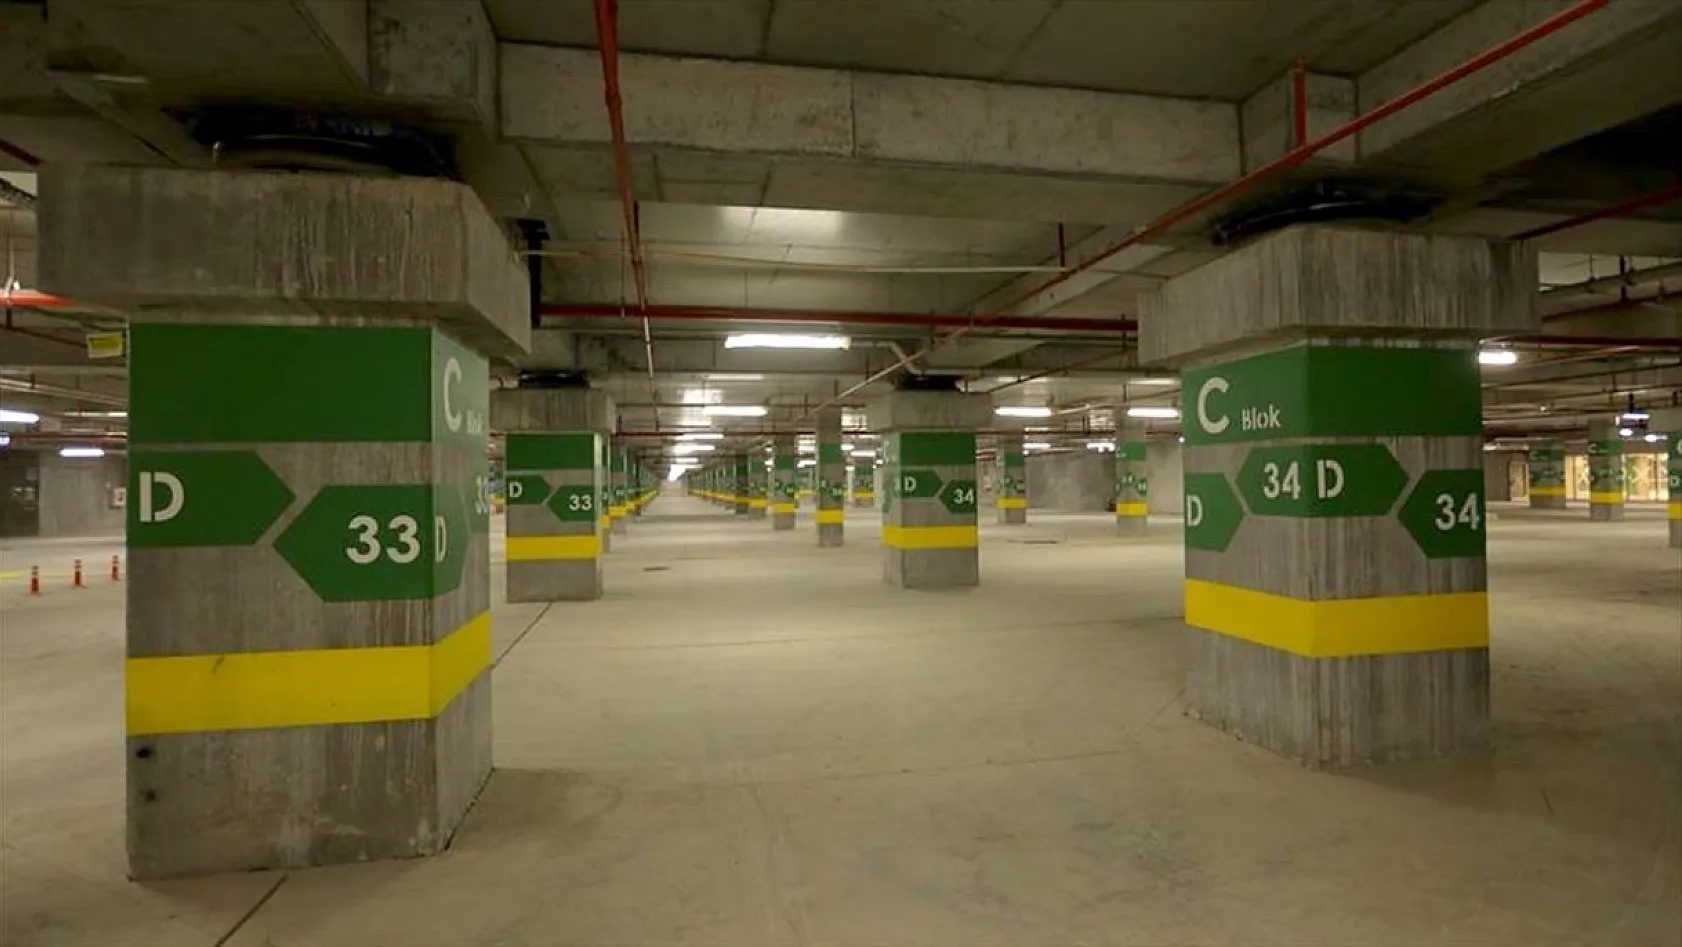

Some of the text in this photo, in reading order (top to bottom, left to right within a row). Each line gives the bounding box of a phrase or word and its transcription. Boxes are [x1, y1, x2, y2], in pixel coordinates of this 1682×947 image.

[444, 357, 462, 433] C
[1197, 376, 1281, 434] C Blok
[139, 471, 185, 523] D
[509, 481, 523, 498] D
[904, 476, 917, 492] D
[953, 487, 976, 505] 34
[1263, 459, 1345, 500] 34 D
[568, 493, 593, 511] 33
[1186, 493, 1204, 528] D
[1434, 493, 1481, 531] 34
[345, 514, 447, 564] 33 D
